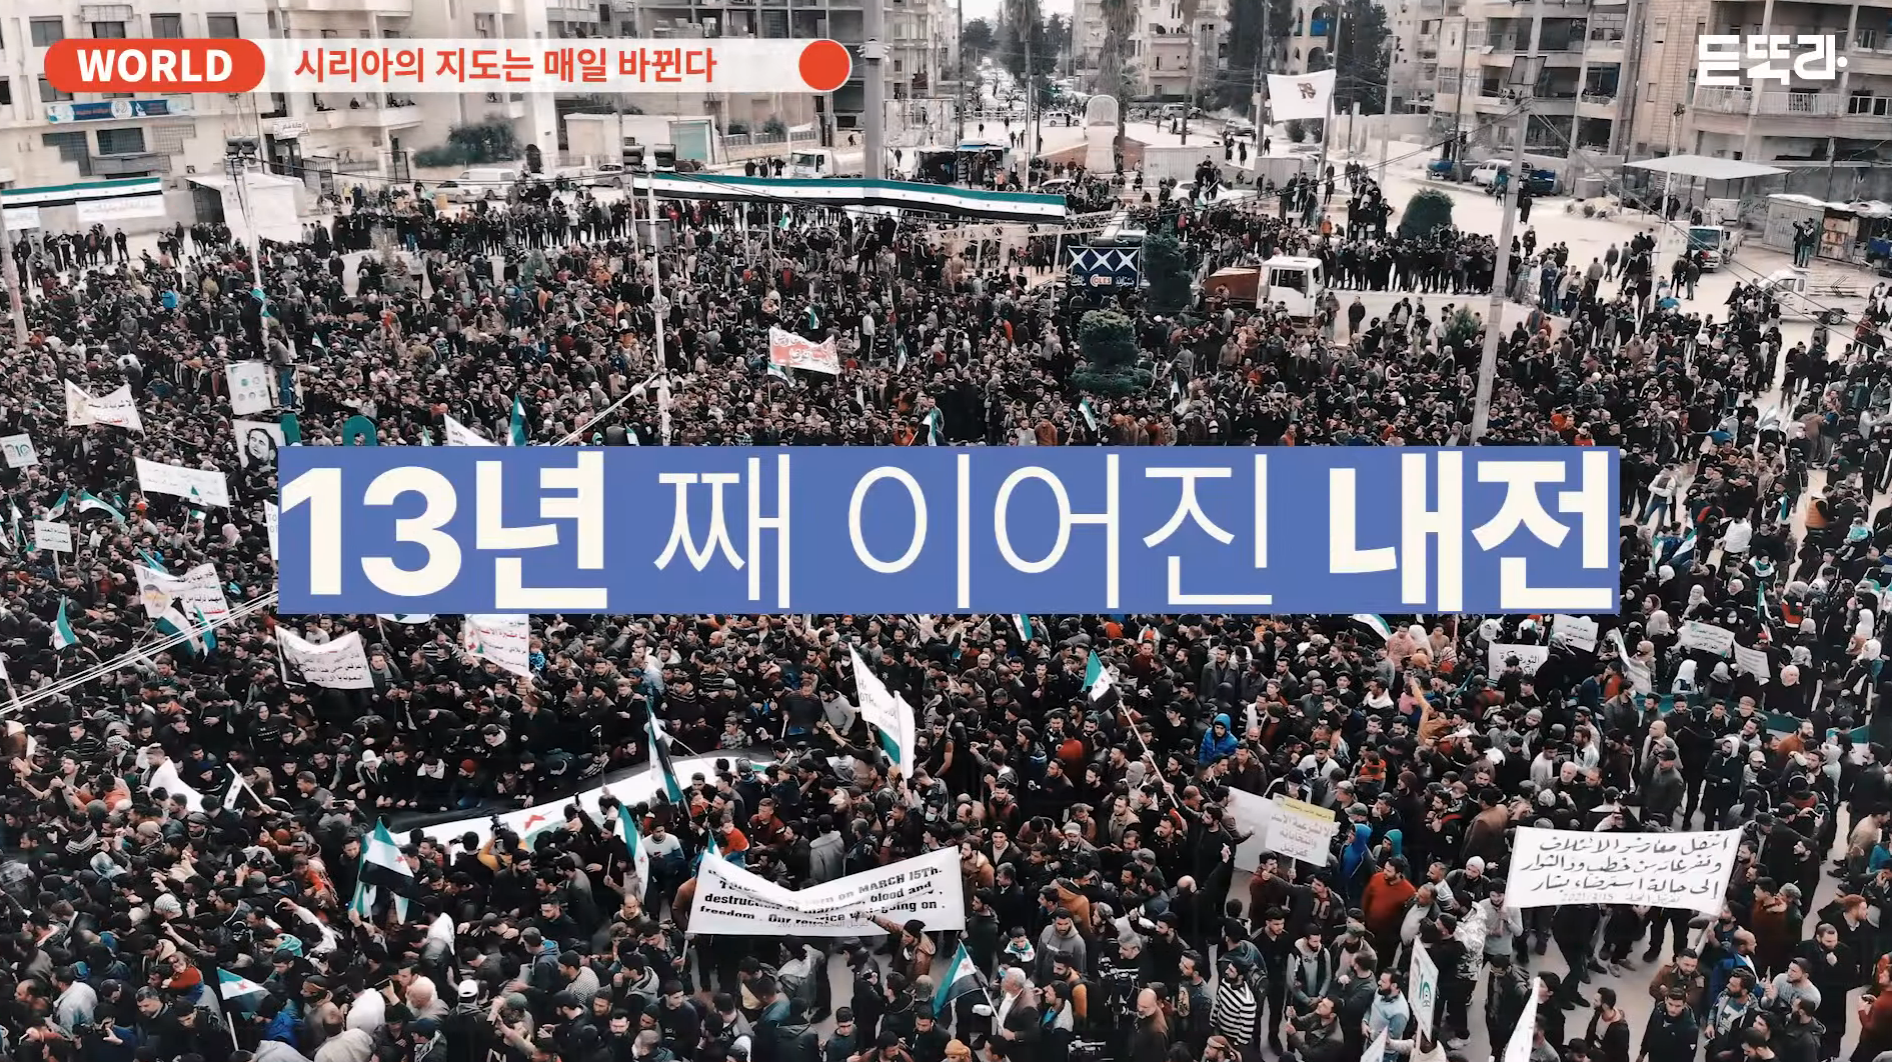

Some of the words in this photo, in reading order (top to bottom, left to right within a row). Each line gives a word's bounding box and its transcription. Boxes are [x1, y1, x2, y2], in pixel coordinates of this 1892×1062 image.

[1680, 833, 1729, 855] انتقل
[858, 873, 905, 894] MARCH
[908, 881, 932, 895] and
[1530, 873, 1570, 893] بشار
[1646, 878, 1687, 893] حالة
[700, 905, 755, 919] freedom
[768, 913, 792, 924] Our
